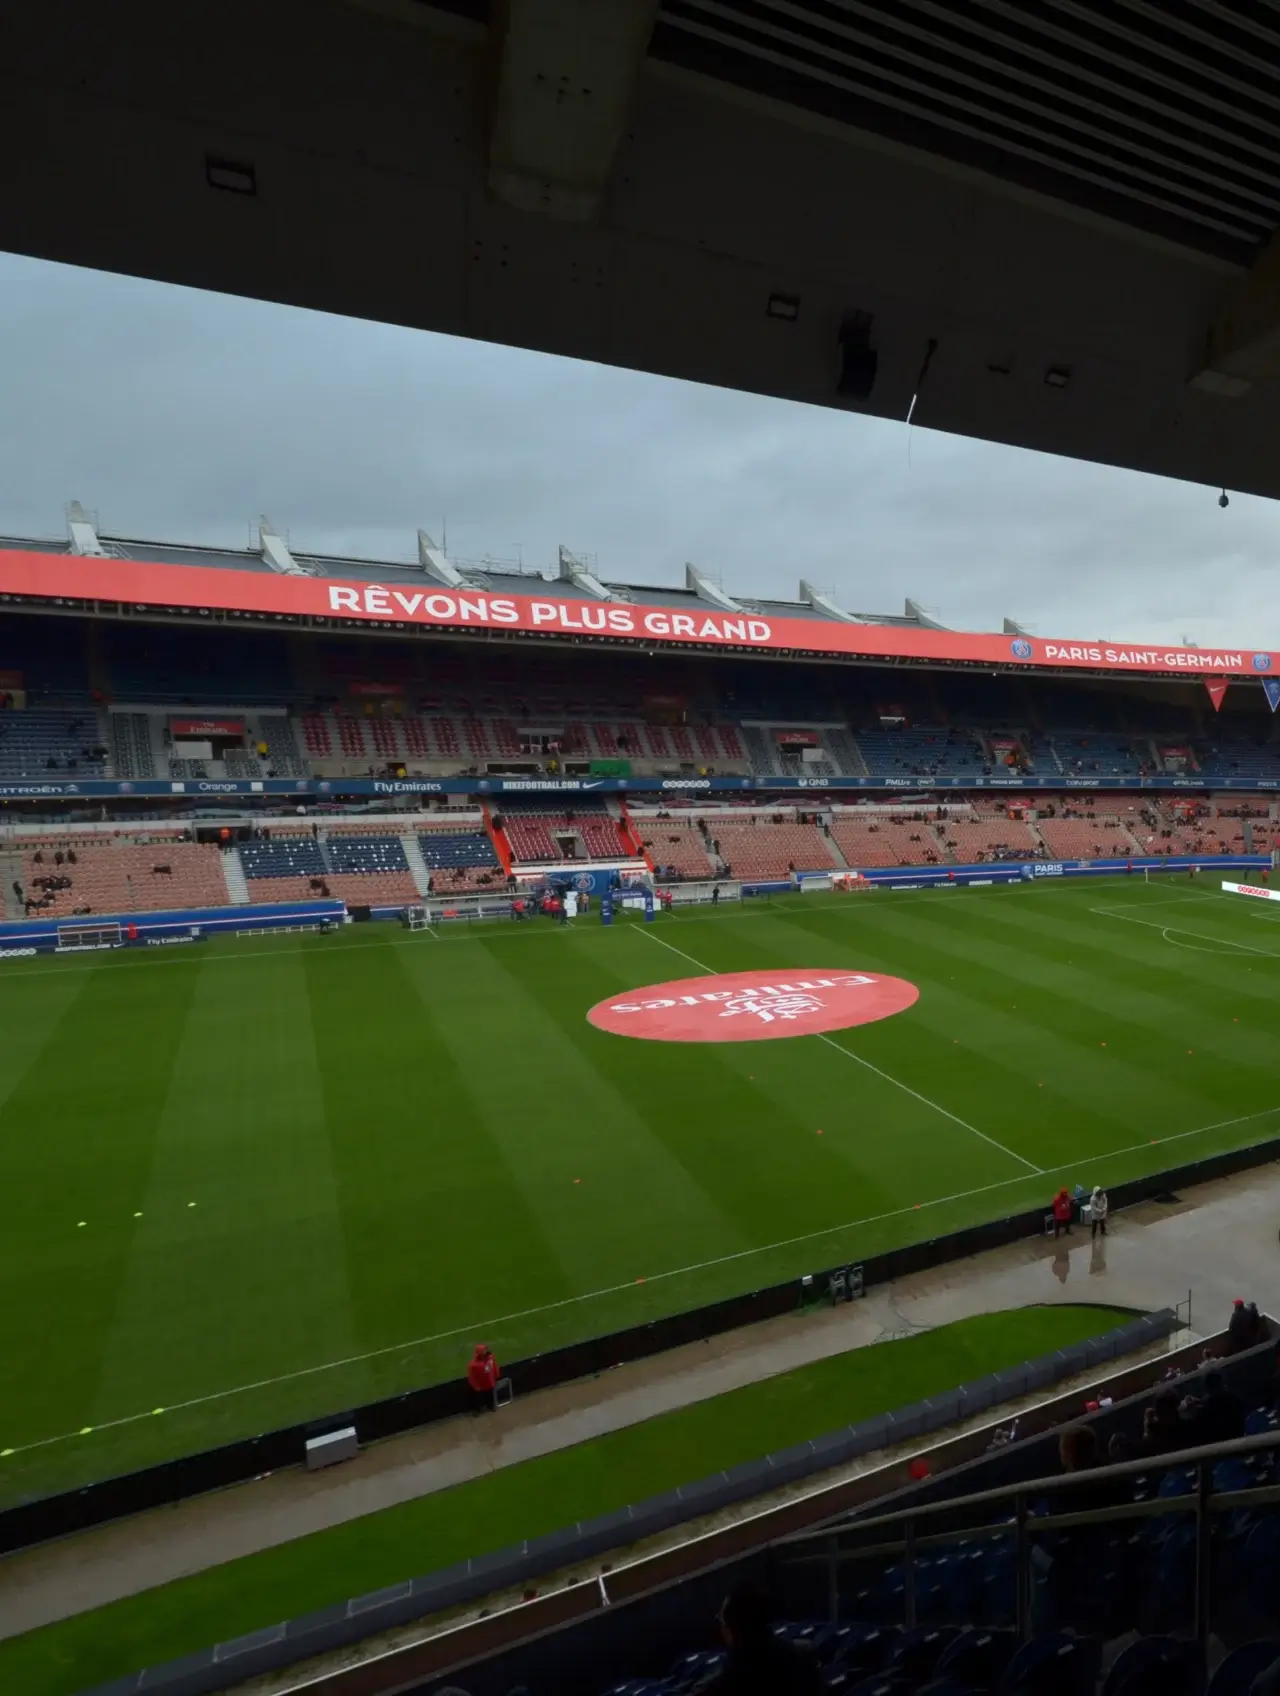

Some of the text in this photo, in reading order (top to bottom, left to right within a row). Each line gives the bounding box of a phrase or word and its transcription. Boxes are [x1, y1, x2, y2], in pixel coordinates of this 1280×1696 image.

[328, 584, 772, 642] RÊVONS PLUS GRAND
[1044, 644, 1243, 668] PARIS SAINT-GERMAIN
[198, 782, 238, 792] Orange
[374, 782, 442, 793] Fly Emirates
[808, 778, 829, 787] QNB
[1034, 863, 1064, 873] PARIS
[1237, 884, 1270, 898] ooredoo
[609, 974, 880, 1013] Emirates
